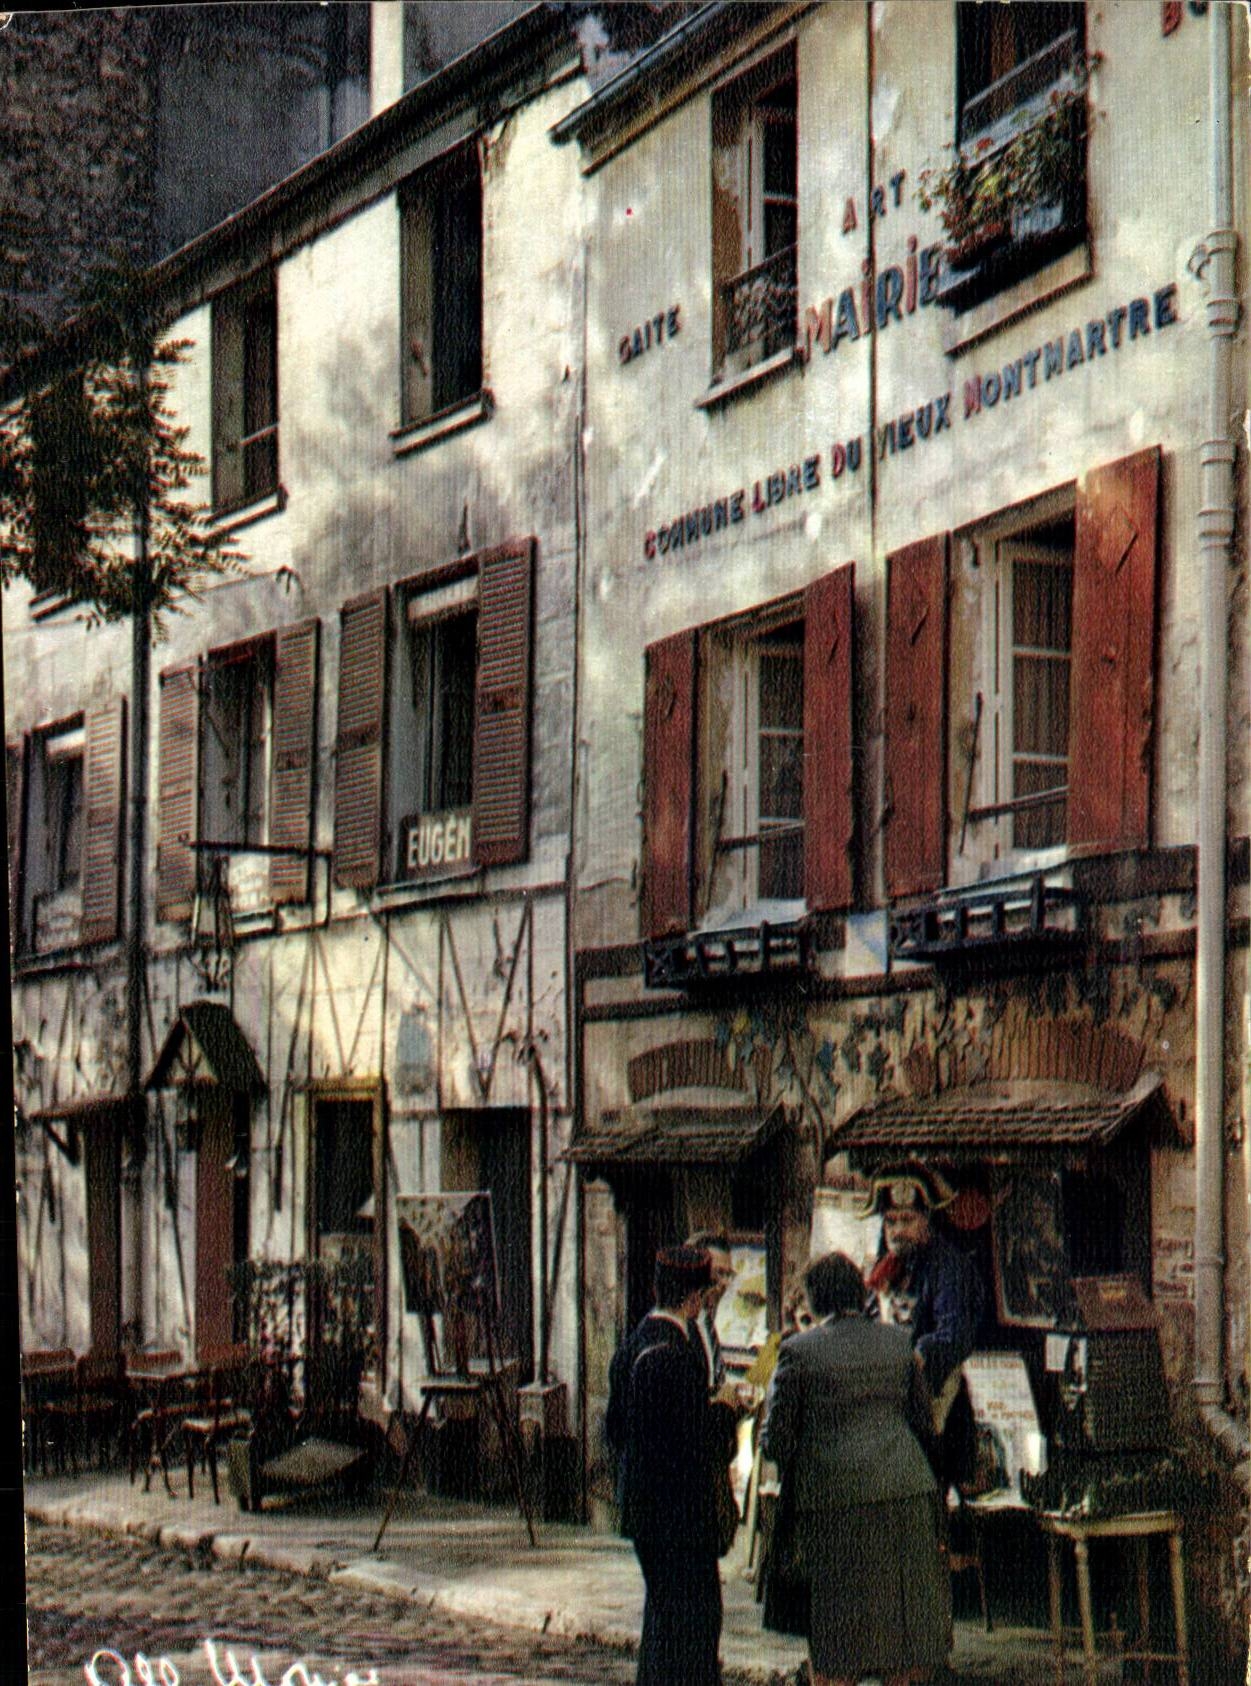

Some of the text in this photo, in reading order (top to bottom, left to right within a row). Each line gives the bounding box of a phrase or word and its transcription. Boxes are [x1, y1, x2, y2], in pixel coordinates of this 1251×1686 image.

[843, 169, 907, 235] ART
[619, 303, 682, 366] GAITE
[644, 282, 1178, 560] COMMUNE LIBRE DU VIEUX MONTMARTRE
